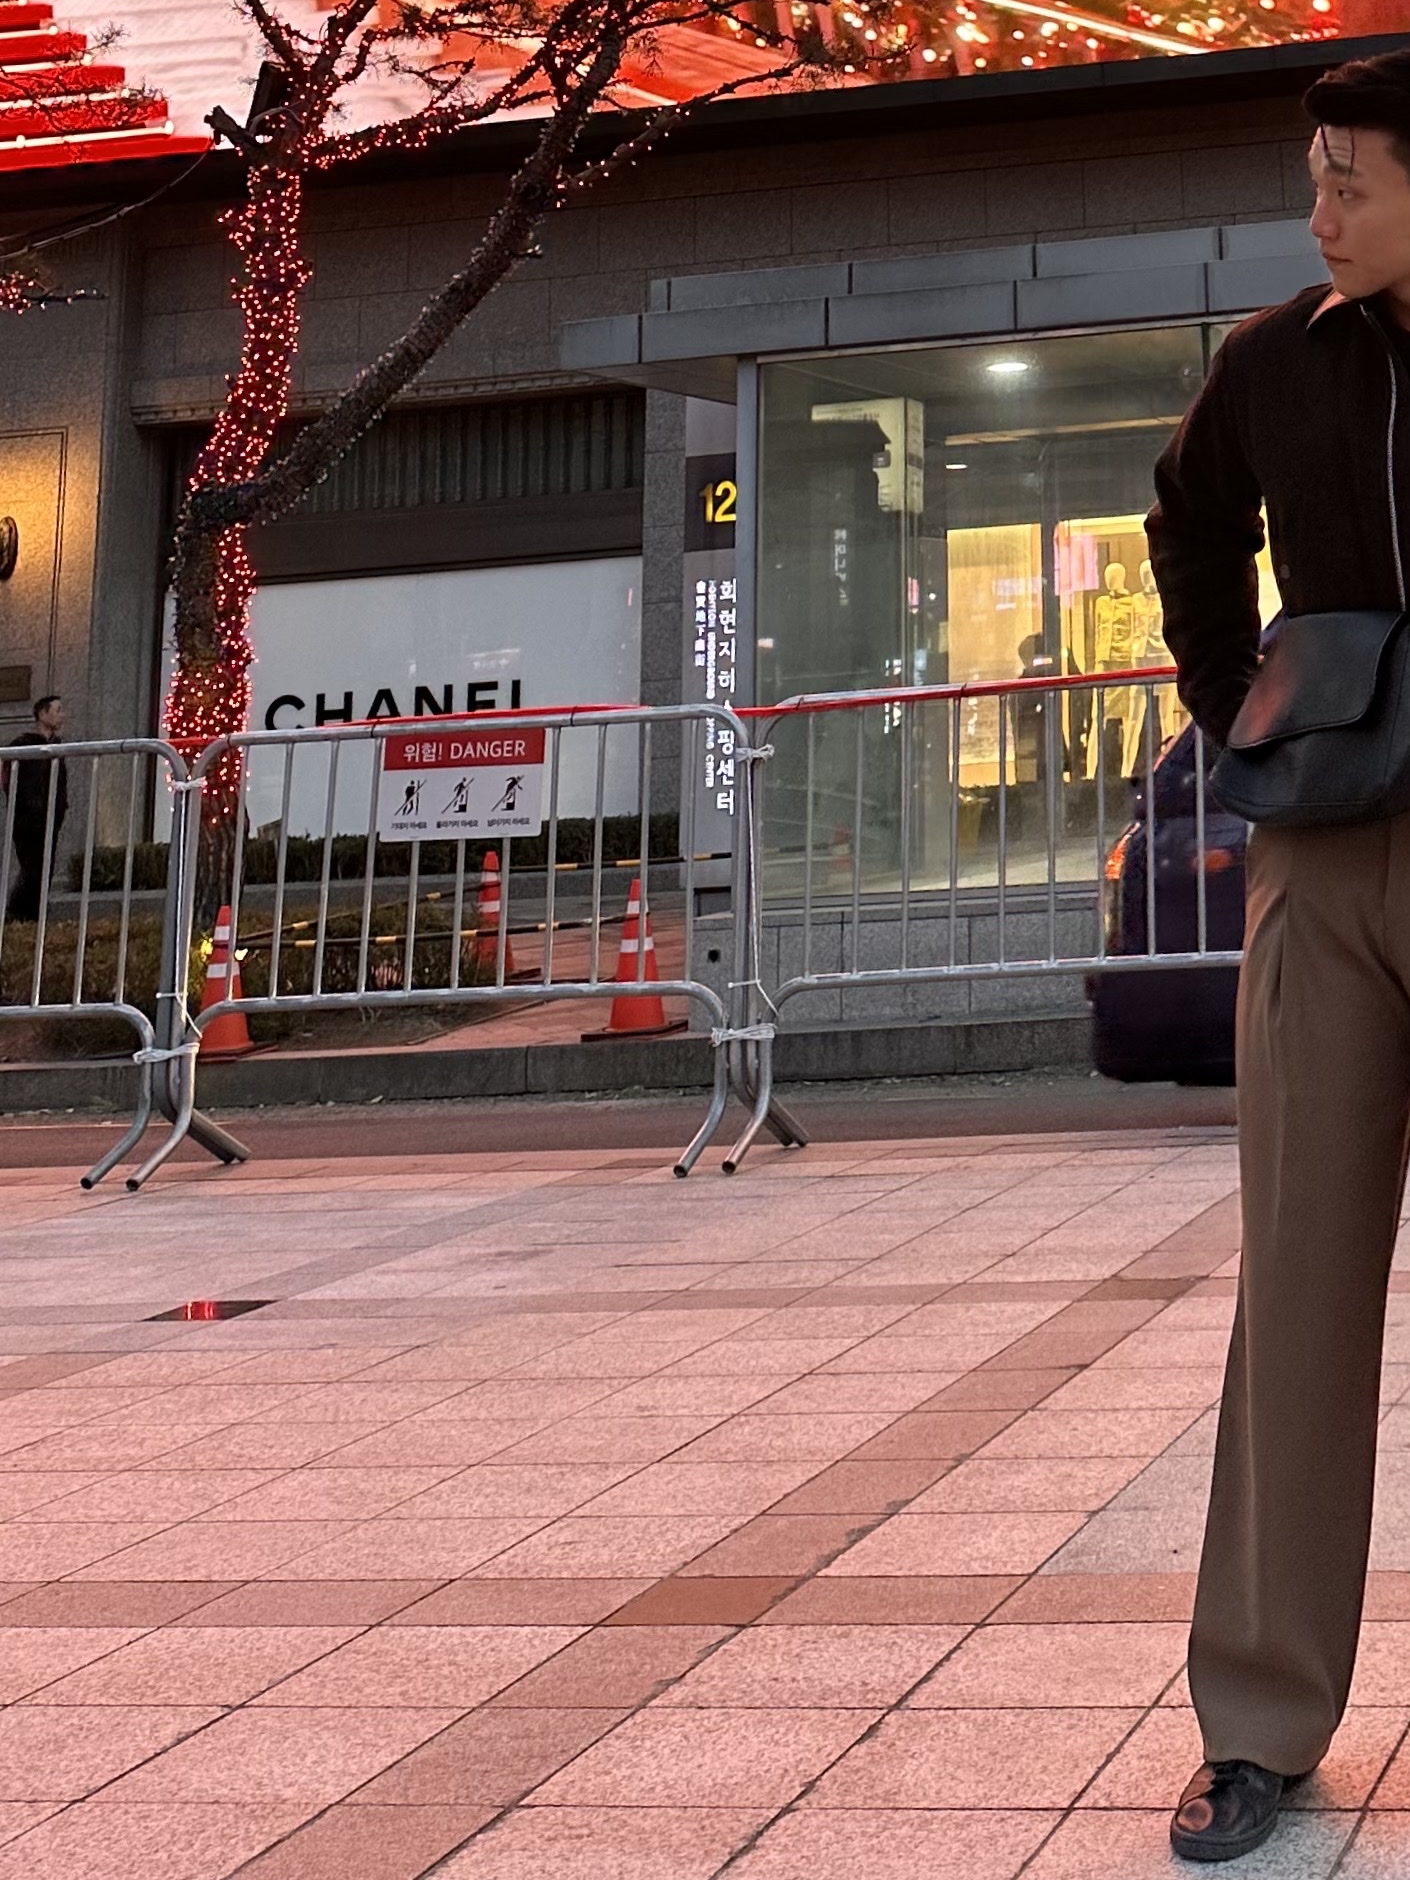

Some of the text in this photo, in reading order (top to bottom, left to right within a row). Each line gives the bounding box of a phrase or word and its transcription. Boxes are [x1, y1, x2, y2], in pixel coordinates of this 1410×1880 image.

[700, 480, 737, 522] 12
[715, 578, 737, 815] 회현지하핑센터
[403, 740, 526, 763] 위험! DANGER
